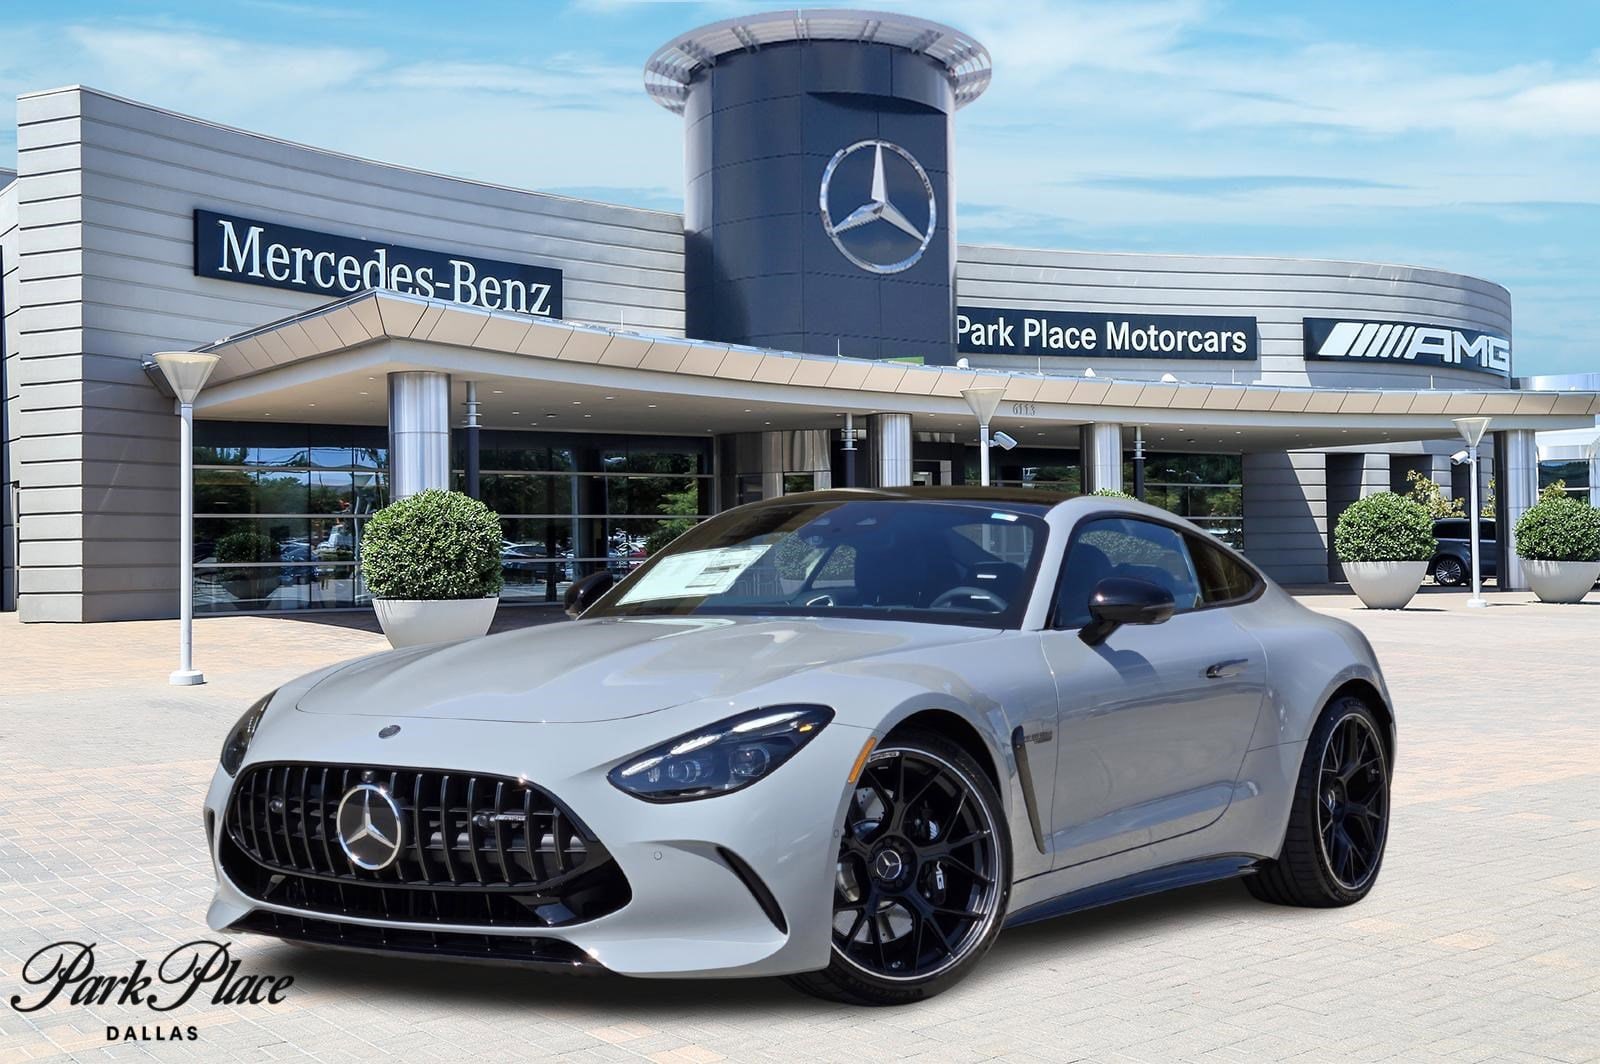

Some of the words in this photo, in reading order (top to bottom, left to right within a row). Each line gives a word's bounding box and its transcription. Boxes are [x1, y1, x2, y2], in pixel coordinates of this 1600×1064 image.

[218, 219, 551, 317] Mercedes-Benz
[957, 315, 1015, 346] Park
[1024, 318, 1097, 350] Place
[1106, 321, 1247, 353] Motorcars
[1013, 403, 1036, 416] 6113
